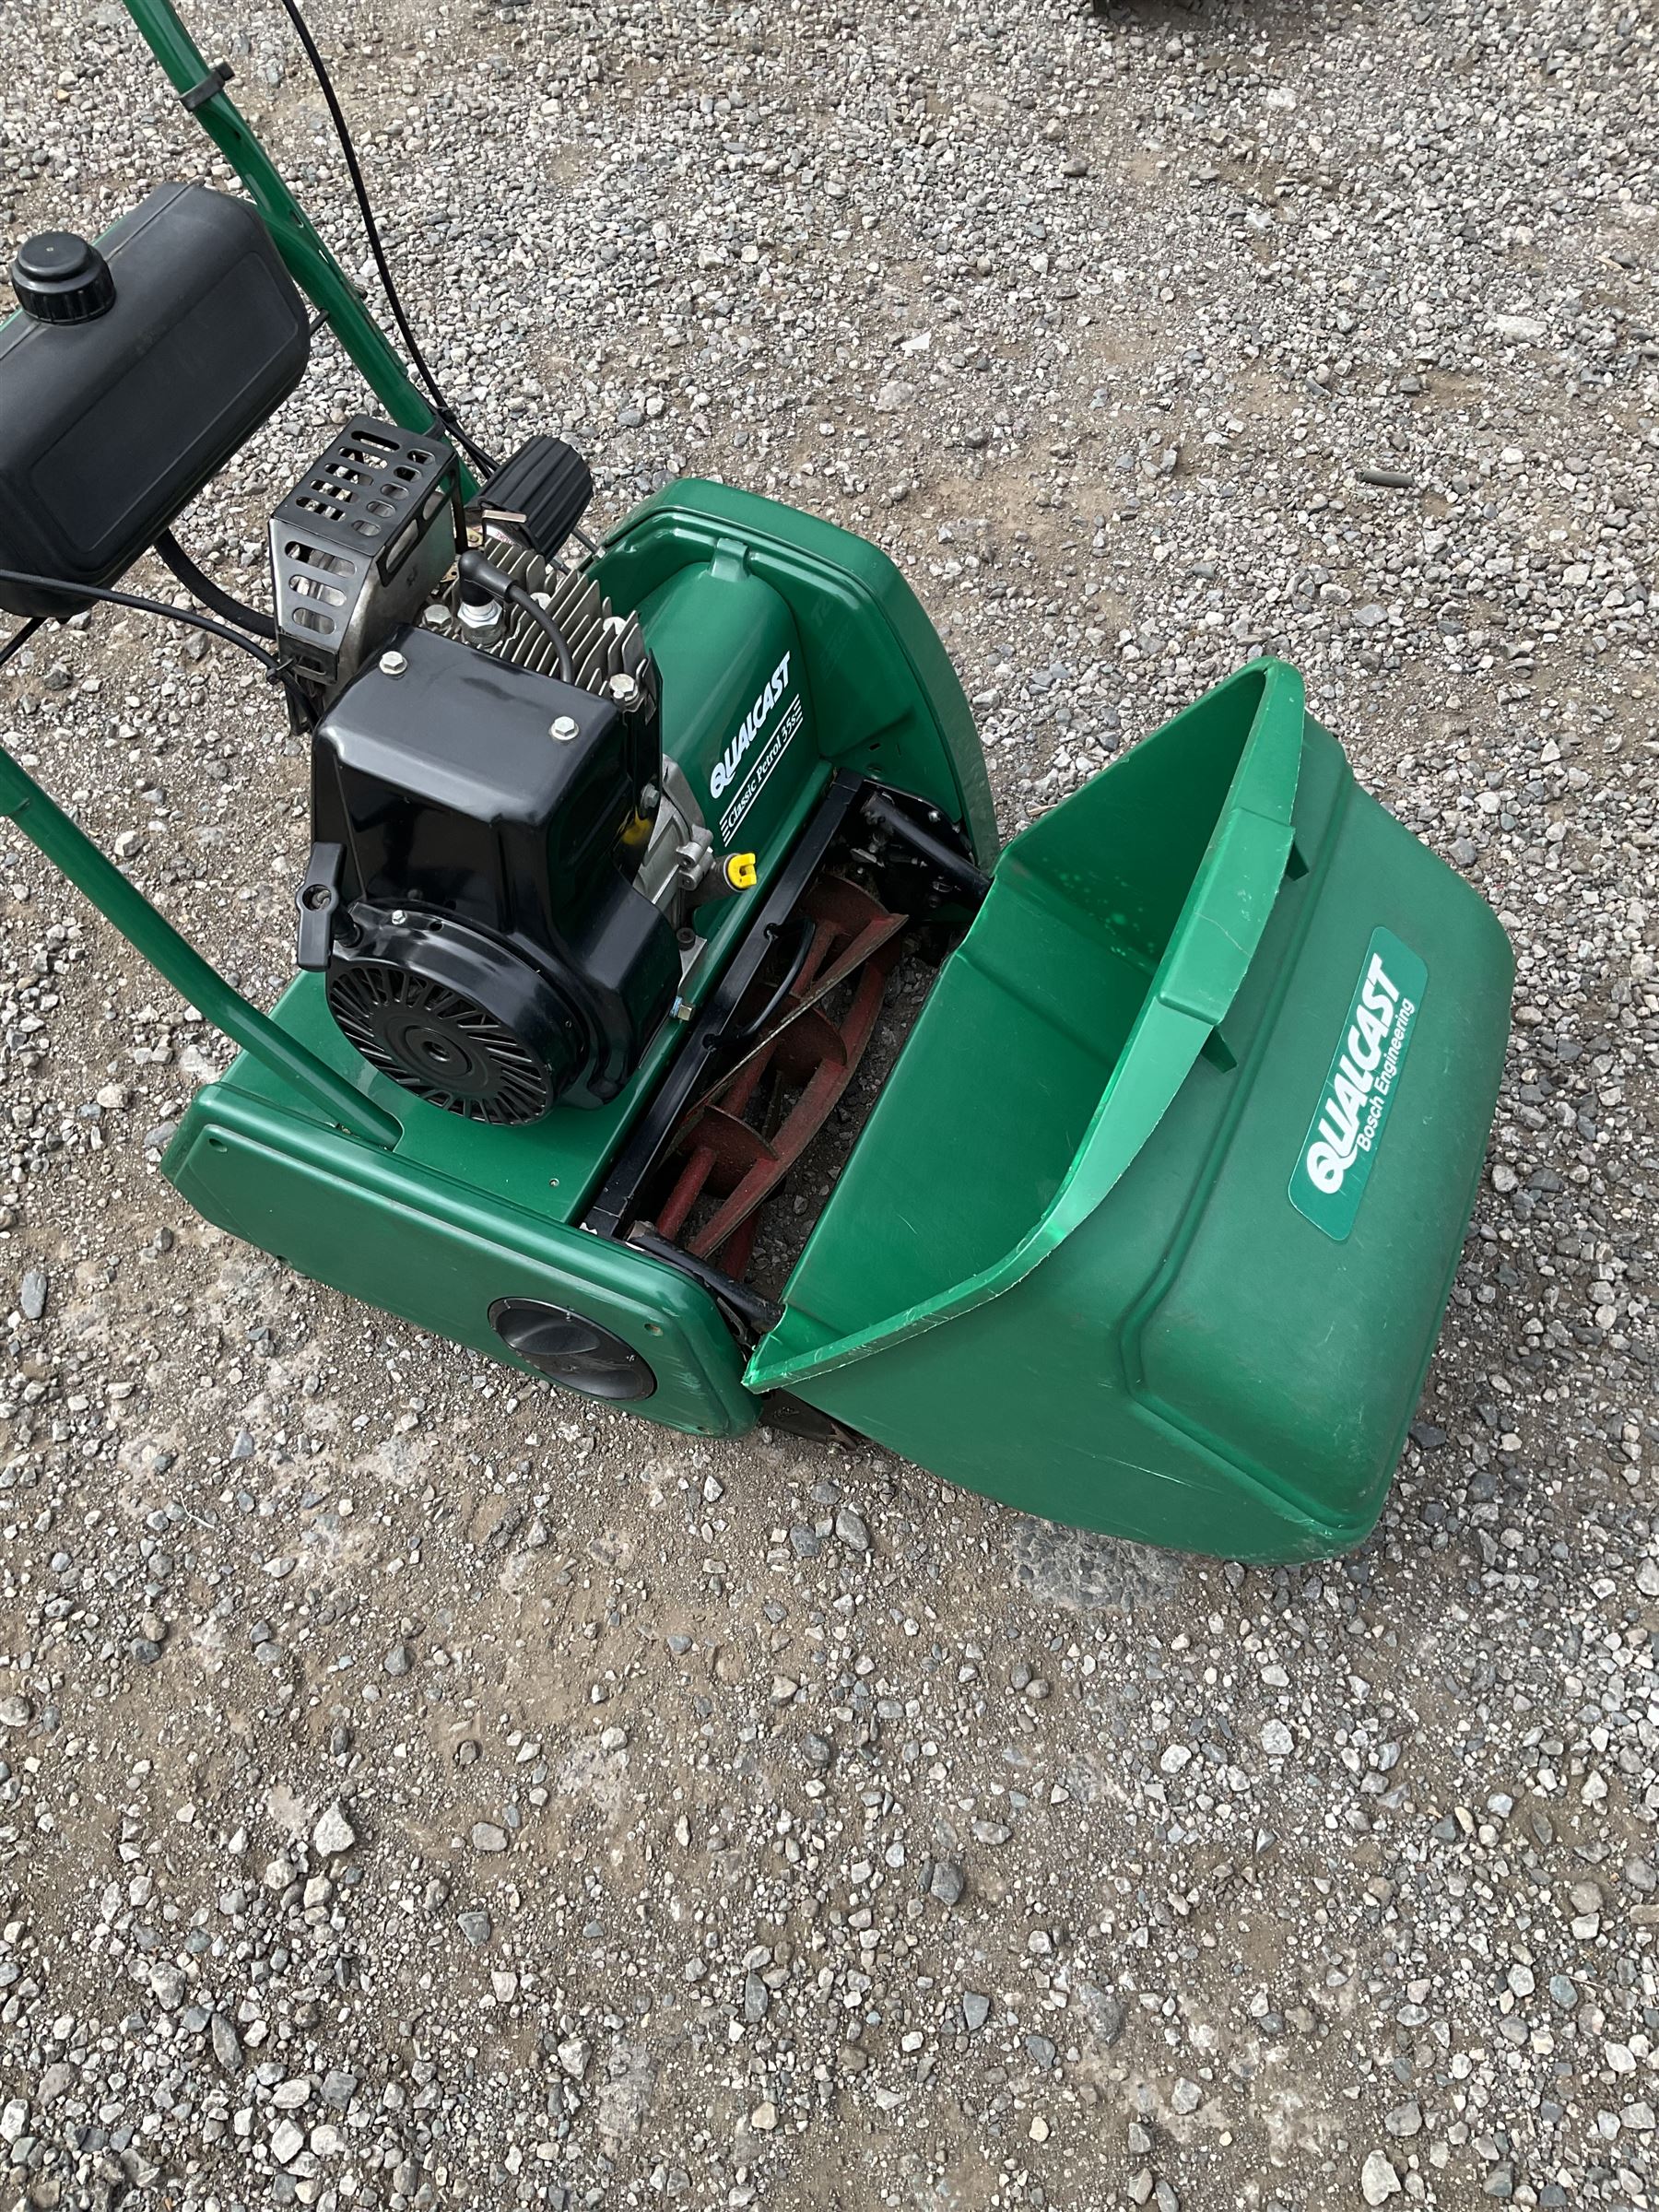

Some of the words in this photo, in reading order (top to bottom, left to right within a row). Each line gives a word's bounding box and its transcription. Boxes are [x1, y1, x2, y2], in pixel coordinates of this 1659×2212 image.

[710, 650, 791, 799] QUALCAST
[727, 782, 757, 828] Classic
[756, 740, 782, 783] Petrol
[1306, 952, 1400, 1194] QUALCAST
[1356, 1094, 1385, 1152] Bosch
[1373, 997, 1415, 1095] Engineering
